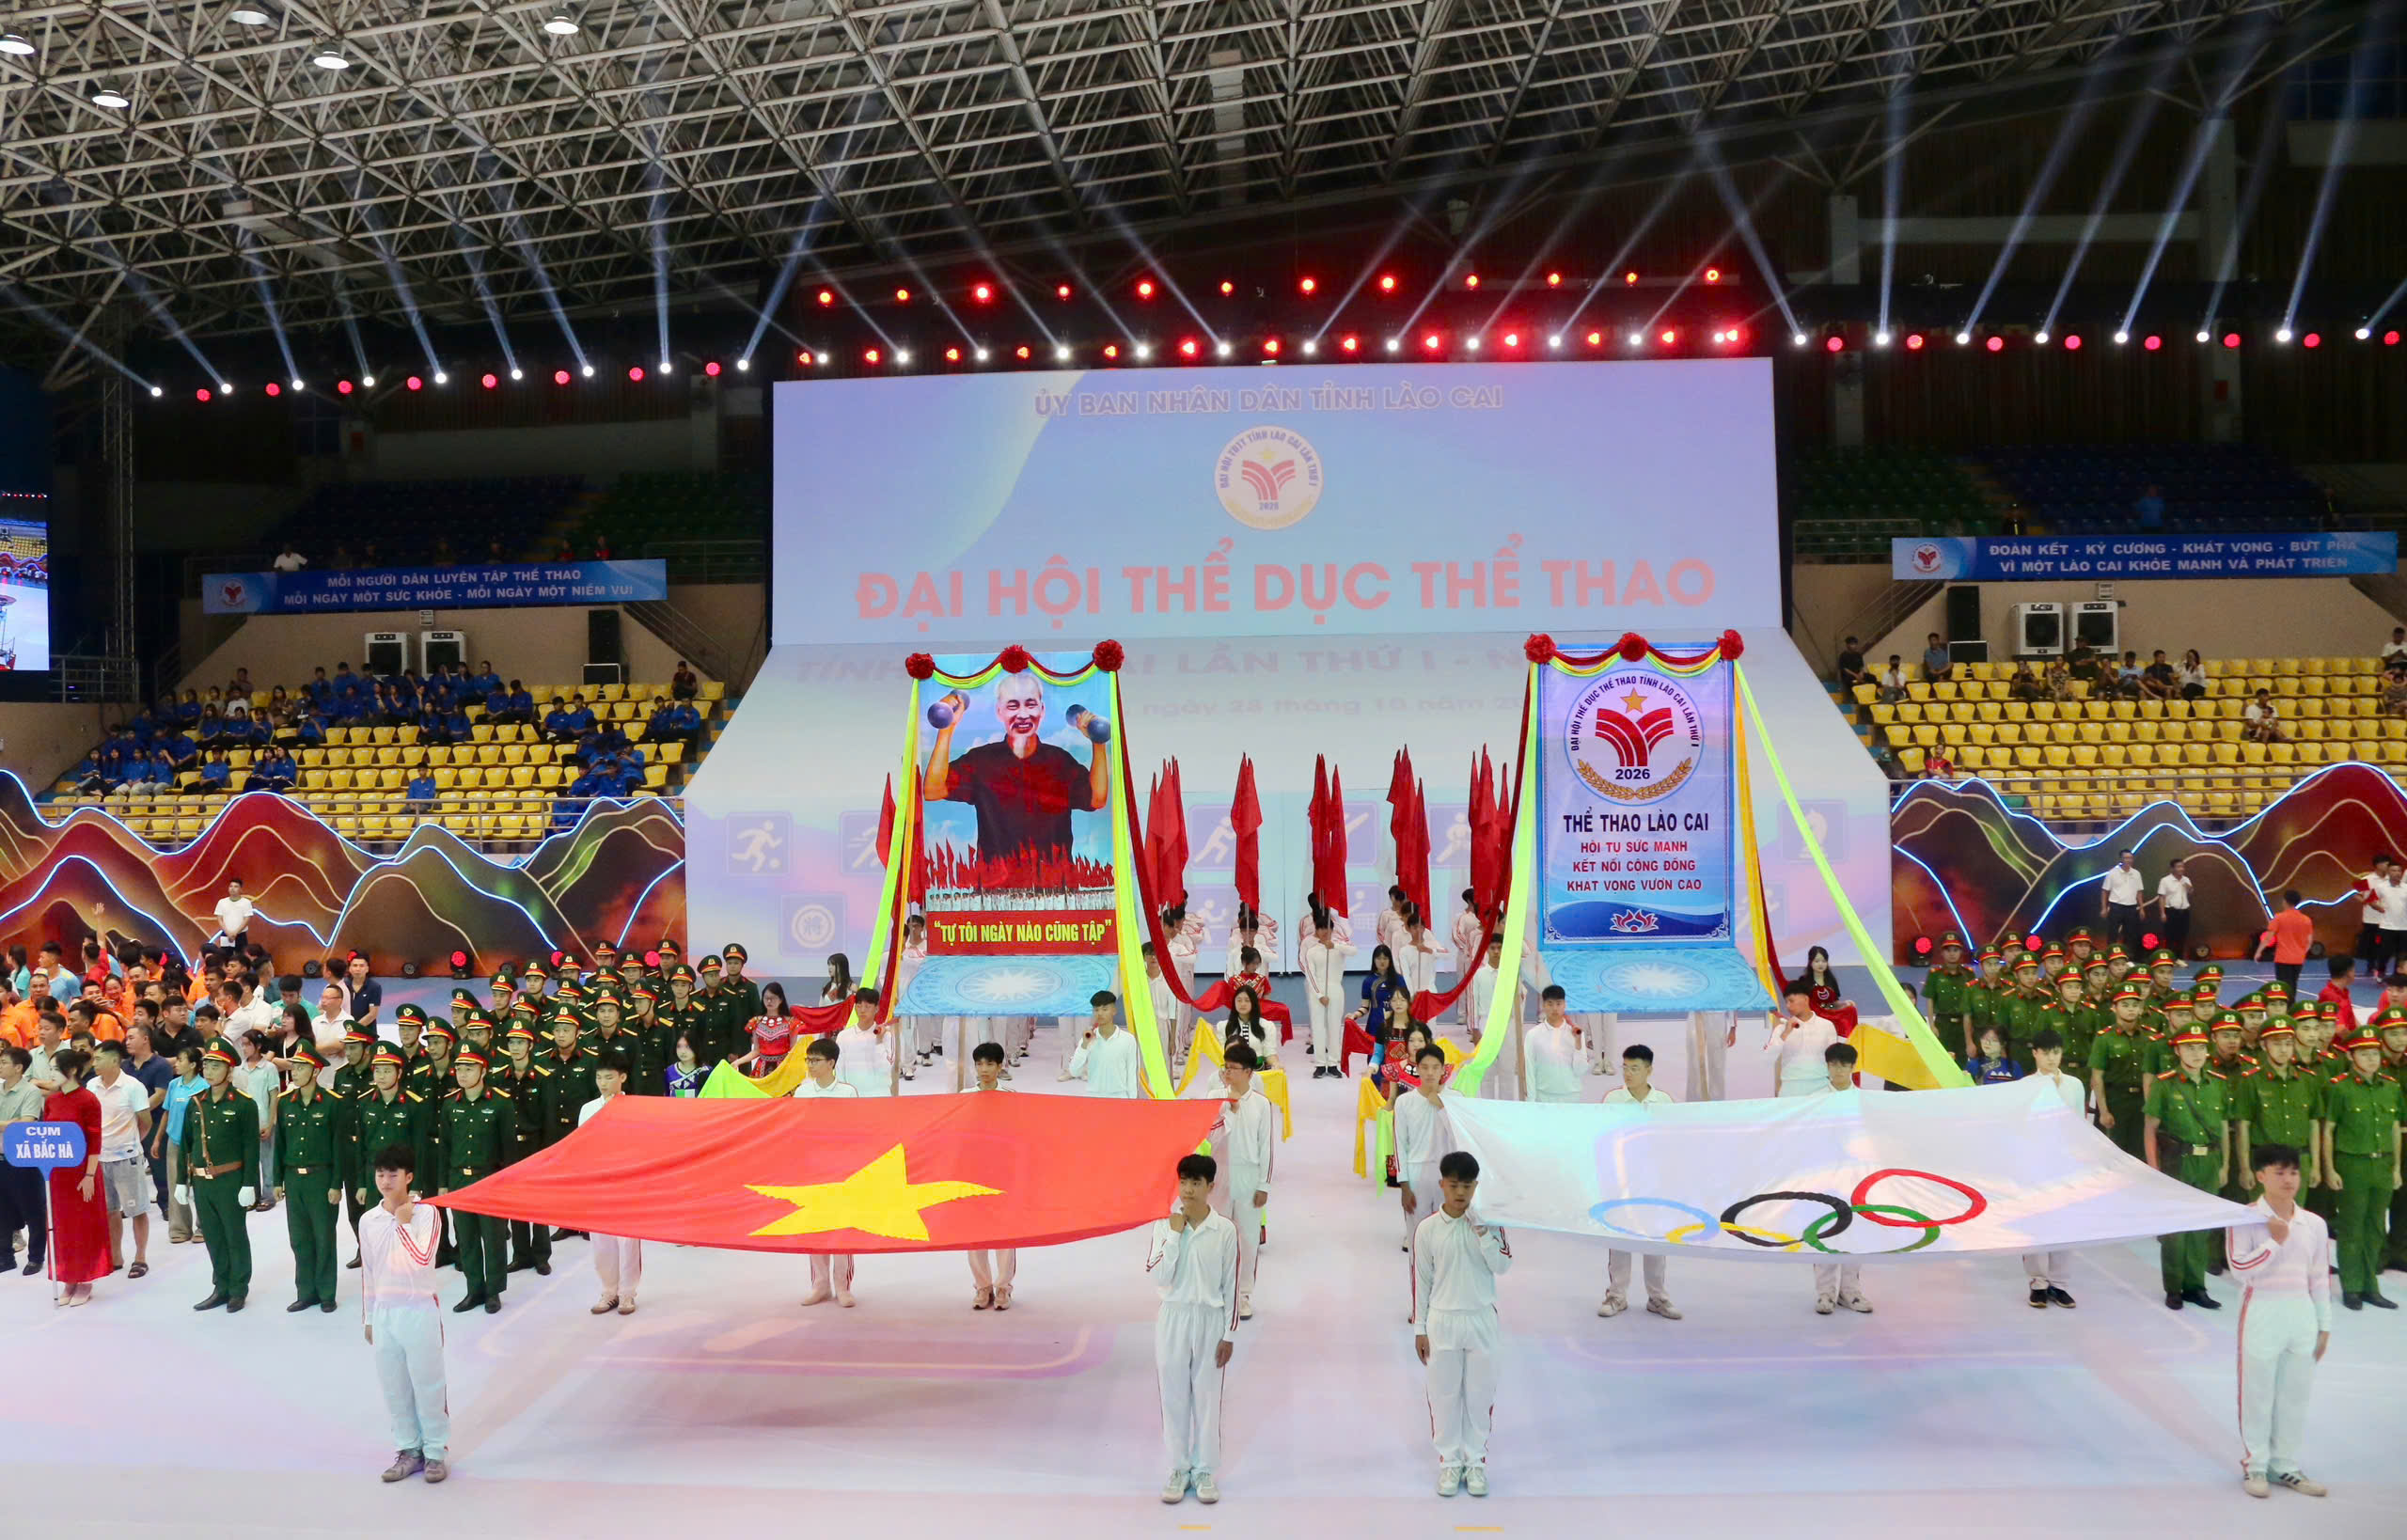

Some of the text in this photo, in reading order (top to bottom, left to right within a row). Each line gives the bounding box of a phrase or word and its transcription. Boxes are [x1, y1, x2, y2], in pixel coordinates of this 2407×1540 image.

[1034, 381, 1503, 416] ỦY BAN NHÂN DÂN TỈNH LÀO CAI
[1989, 542, 2032, 556] ĐOÀN
[2038, 542, 2069, 556] KẾT
[2113, 542, 2166, 555] CƯƠNG
[2182, 541, 2225, 554] KHÁT
[2230, 542, 2273, 556] VỌNG
[2000, 559, 2015, 572] VÌ
[2022, 559, 2053, 574] MỘT
[2060, 558, 2090, 572] LÀO
[2097, 560, 2122, 571] CAI
[2178, 559, 2222, 573] MẠNH
[2228, 557, 2249, 569] VÀ
[402, 573, 428, 585] DÂN
[434, 570, 477, 585] LUYỆN
[482, 570, 508, 584] TẬP
[544, 570, 581, 580] THAO
[855, 532, 1716, 633] ĐẠI HỘI THỂ DỤC THỂ THAO
[385, 589, 411, 602] SỨC
[496, 585, 533, 598] NGÀY
[539, 585, 566, 599] MỘT
[611, 586, 633, 595] VUI
[1615, 675, 1636, 686] THAO
[1639, 674, 1659, 687] TỈNH
[1659, 682, 1675, 696] LÀO
[1584, 690, 1599, 706] DỤC
[1674, 693, 1687, 707] CAI
[1682, 706, 1696, 724] LẦN
[1571, 722, 1581, 735] HỘI
[1689, 725, 1701, 742] THỨ
[1571, 737, 1581, 751] ĐẠI
[1615, 768, 1651, 780] 2026
[1563, 806, 1709, 833] THỂ THAO LÀO CAI
[1581, 839, 1688, 856] HỘI TỤ SỨC MẠNH
[1573, 857, 1695, 874] KẾT NỐI CỘNG ĐỒNG
[1604, 880, 1636, 894] VỌNG
[1641, 879, 1673, 890] VƯƠN
[1678, 879, 1702, 890] CAO
[934, 919, 1112, 947] “TỰ TÔI NGÀY NÀO CŨNG TẬP”
[25, 1126, 61, 1139] CỤM
[15, 1138, 74, 1159] XÃ BẮC HÀ
